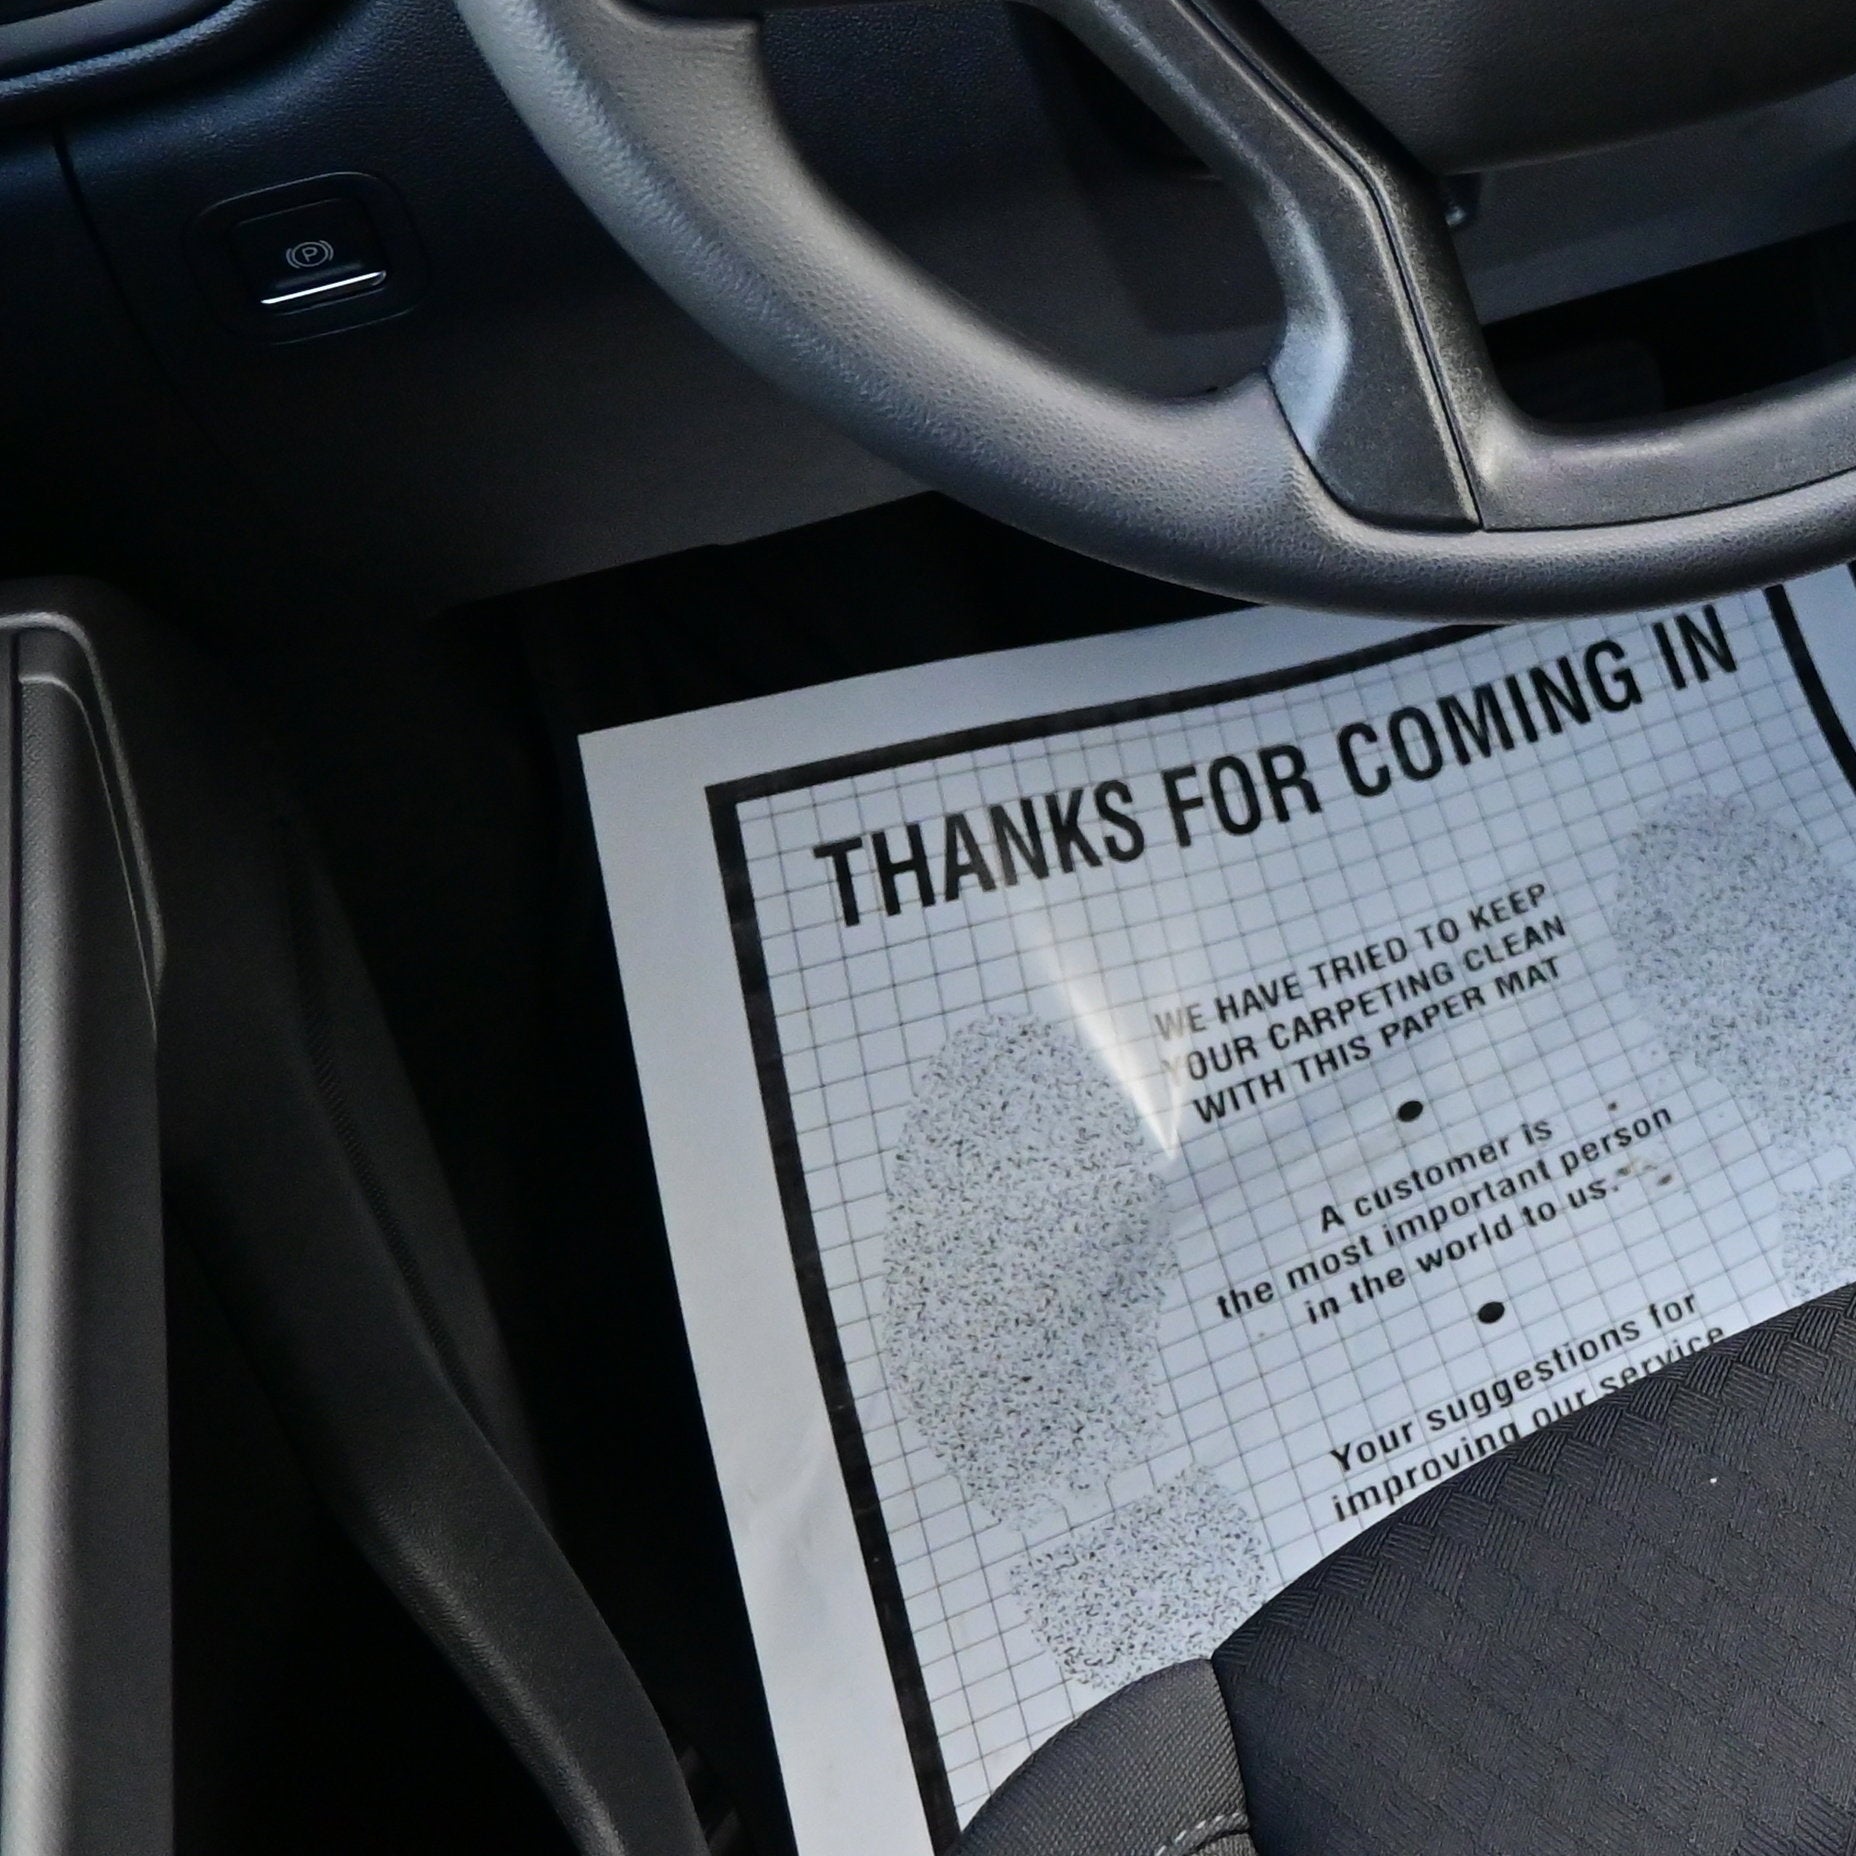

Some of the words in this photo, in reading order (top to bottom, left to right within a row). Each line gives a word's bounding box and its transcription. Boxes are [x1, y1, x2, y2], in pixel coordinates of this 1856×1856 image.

[814, 778, 1146, 927] THANKS
[1162, 743, 1323, 848] FOR
[1336, 639, 1643, 799] COMING
[1652, 604, 1739, 691] IN
[1154, 1002, 1208, 1042] WE
[1215, 971, 1303, 1027] HAVE
[1309, 937, 1410, 994] TRIED
[1415, 918, 1460, 954] TO
[1467, 882, 1546, 942] KEEP
[1161, 1035, 1259, 1084] YOUR
[1268, 961, 1454, 1050] CARPETING
[1464, 915, 1568, 973] CLEAN
[1193, 1068, 1286, 1126] WITH
[1291, 1035, 1372, 1085] THIS
[1381, 986, 1487, 1050] PAPER
[1492, 955, 1564, 998] MAT
[1216, 1279, 1276, 1320] the
[1286, 1240, 1375, 1291] most
[1382, 1158, 1553, 1254] important
[1560, 1106, 1674, 1175] person
[1307, 1298, 1342, 1325] in
[1352, 1265, 1408, 1307] the
[1416, 1214, 1515, 1275] world
[1520, 1199, 1558, 1231] to
[1569, 1180, 1619, 1212] us.
[1318, 1204, 1345, 1232] A
[1354, 1143, 1511, 1218] customer
[1518, 1117, 1555, 1151] is
[1330, 1422, 1415, 1473] Your
[1427, 1317, 1642, 1433] suggestions
[1648, 1291, 1699, 1332] for
[1332, 1423, 1520, 1522] improving
[1531, 1389, 1588, 1432] our
[1599, 1324, 1726, 1396] service
